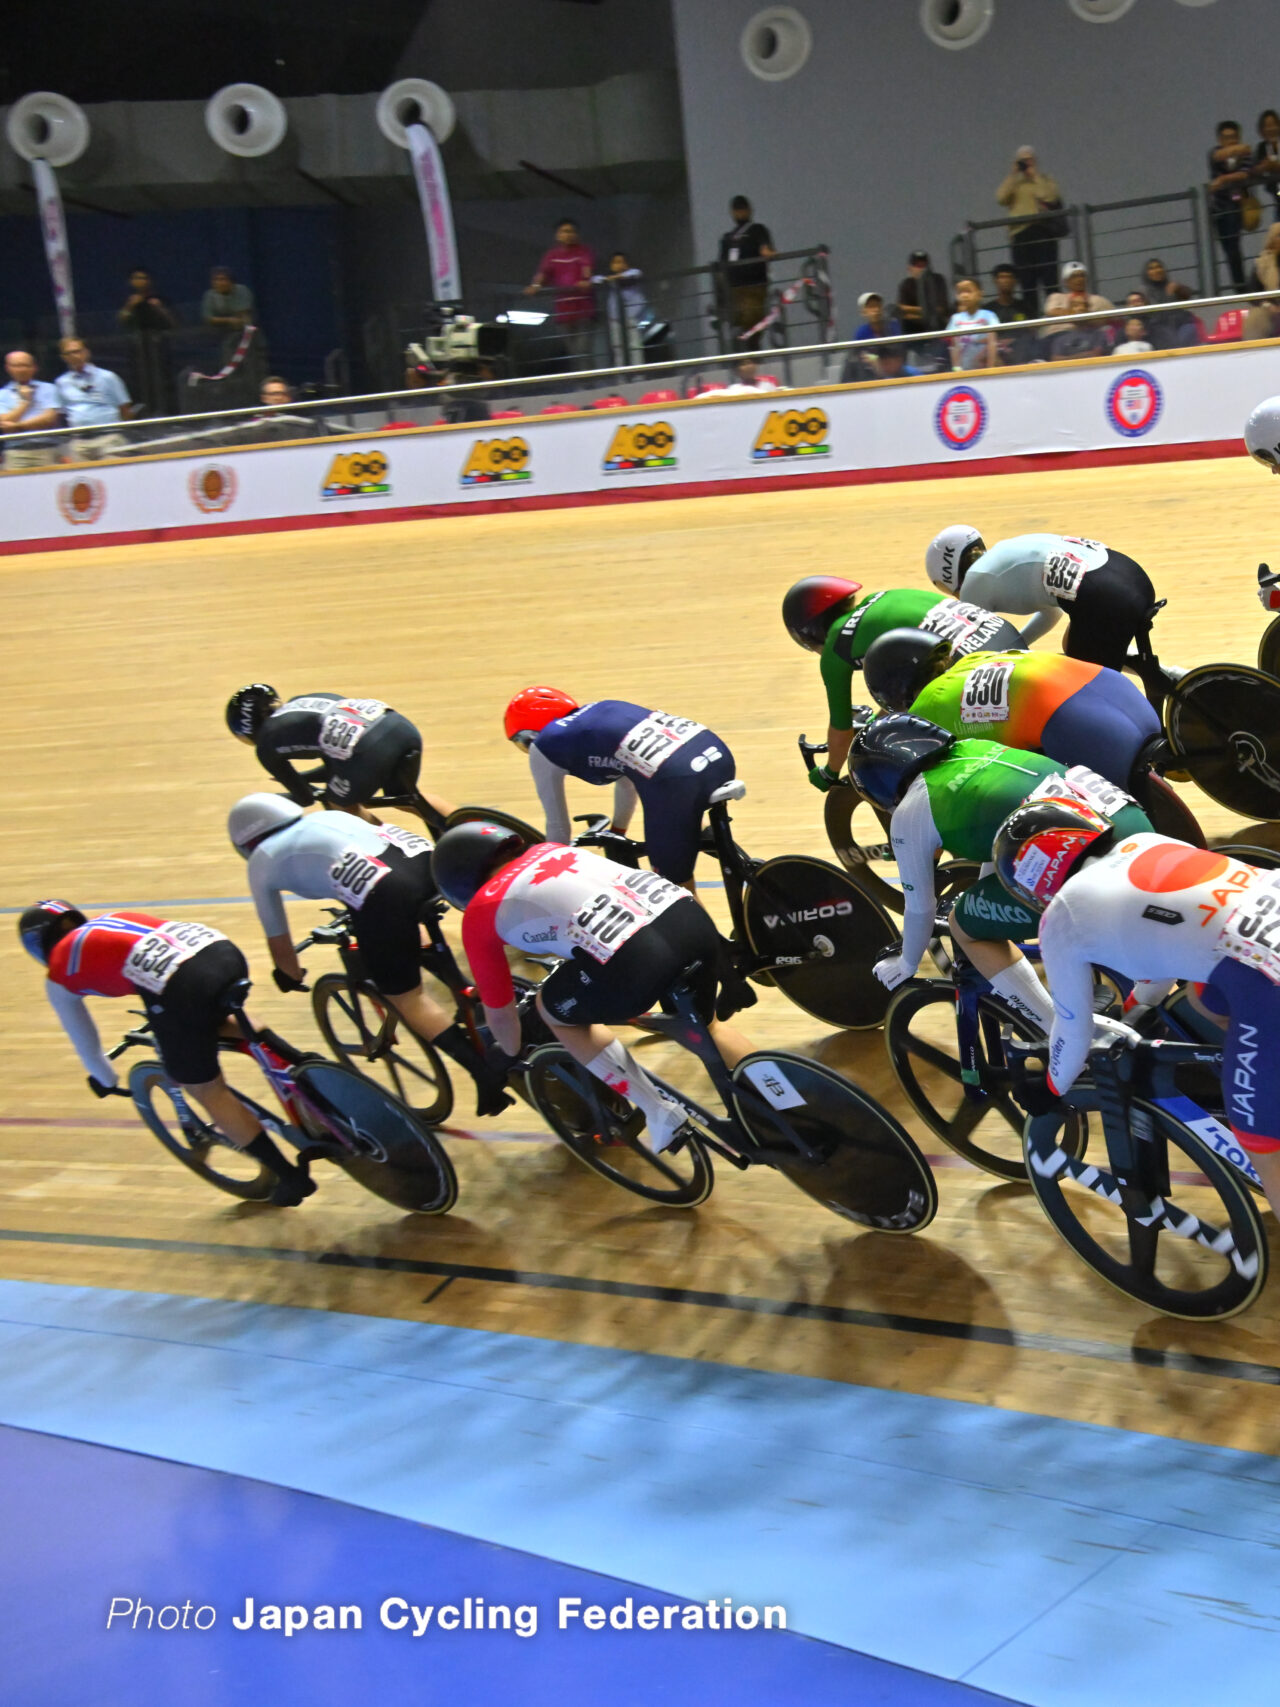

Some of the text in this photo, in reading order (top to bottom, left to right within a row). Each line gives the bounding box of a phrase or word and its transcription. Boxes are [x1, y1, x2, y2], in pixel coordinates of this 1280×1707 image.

[942, 546, 955, 584] KASK
[1046, 555, 1081, 591] 339
[957, 616, 1005, 656] IRELAND
[966, 668, 1007, 707] 330
[324, 719, 358, 749] 336
[627, 727, 673, 761] 317
[588, 756, 627, 772] FRANCE
[331, 852, 378, 895] 308
[1044, 836, 1078, 889] JAPAN
[625, 871, 679, 903] 310
[522, 927, 557, 943] Canada
[577, 894, 635, 944] 310
[131, 938, 180, 978] 334
[1232, 1023, 1259, 1127] JAPAN
